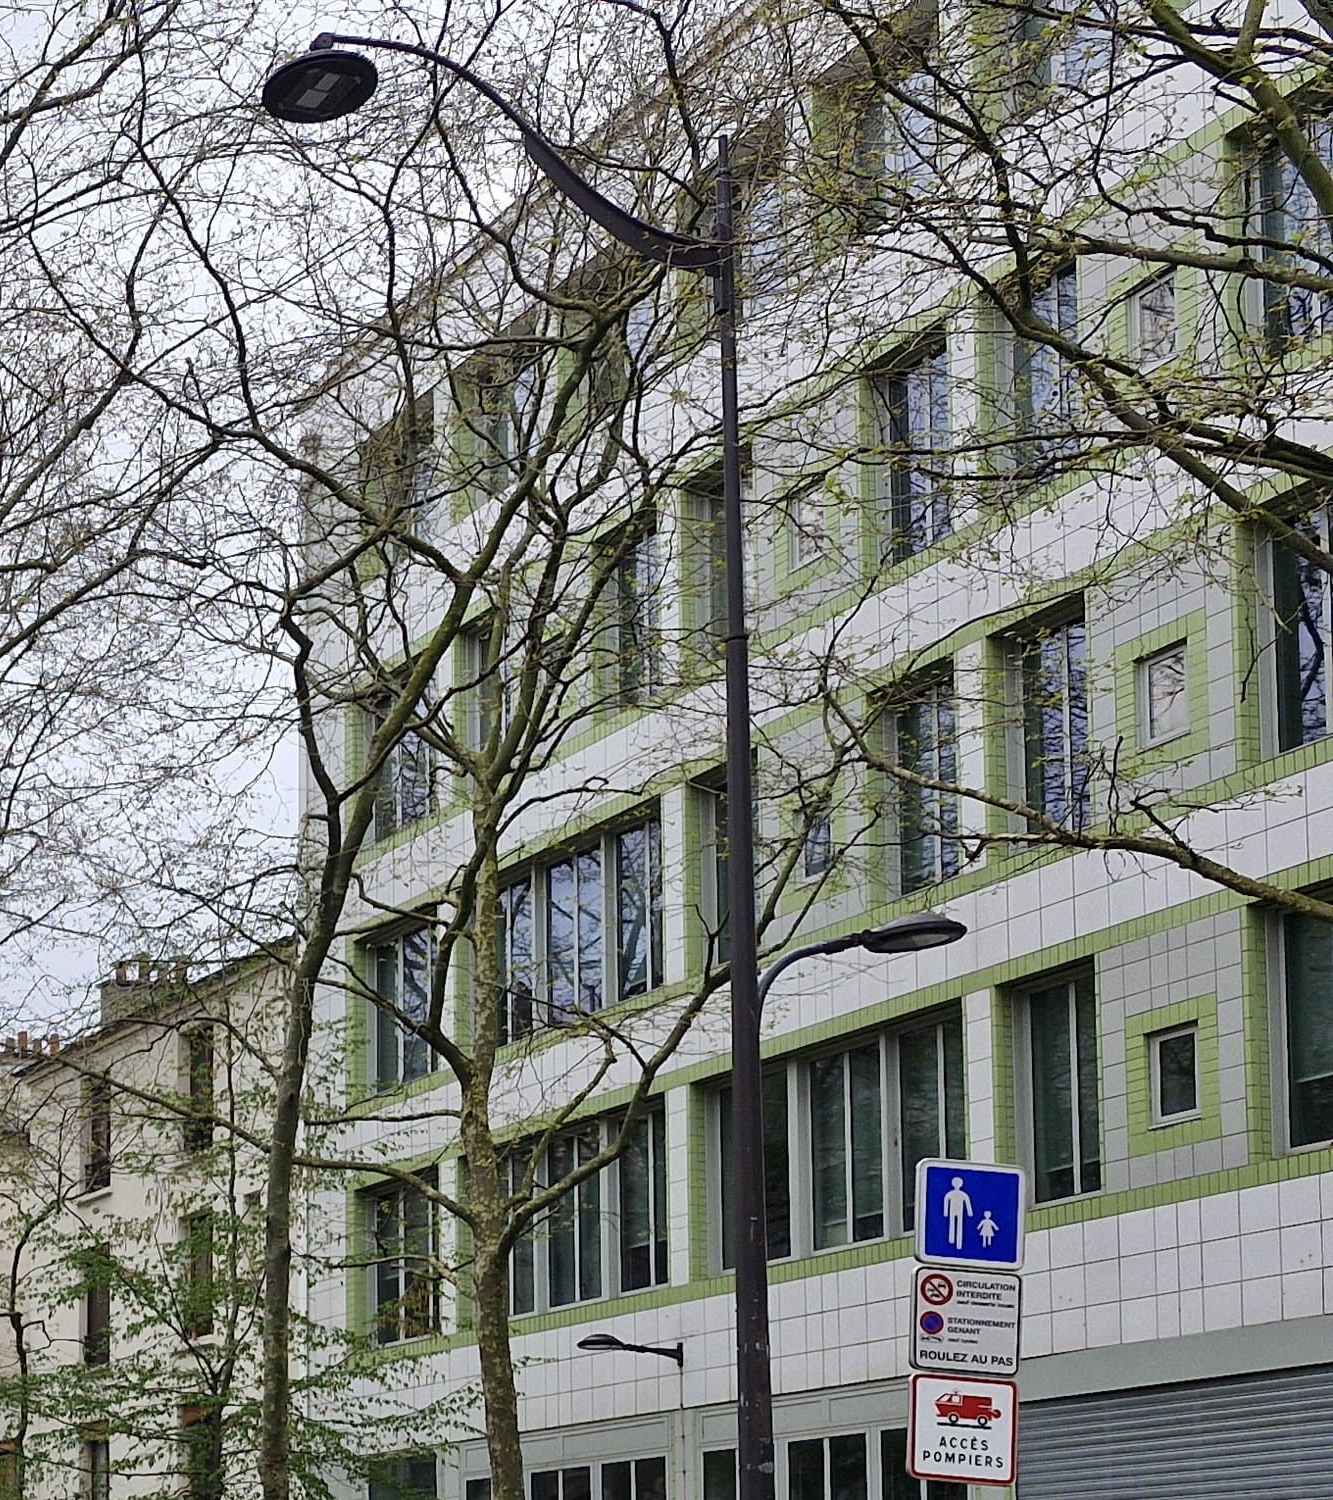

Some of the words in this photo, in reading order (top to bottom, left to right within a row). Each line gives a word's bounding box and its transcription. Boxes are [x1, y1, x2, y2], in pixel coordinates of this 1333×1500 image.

[956, 1280, 1016, 1291] CIRCULATION
[956, 1290, 1002, 1300] INTERDITE
[947, 1317, 1016, 1328] STATIONNEMENT
[919, 1350, 968, 1363] ROULEZ
[971, 1354, 987, 1365] AU
[991, 1355, 1013, 1367] PAS
[939, 1436, 989, 1451] ACCÈS
[922, 1450, 1004, 1468] POMPIERS
